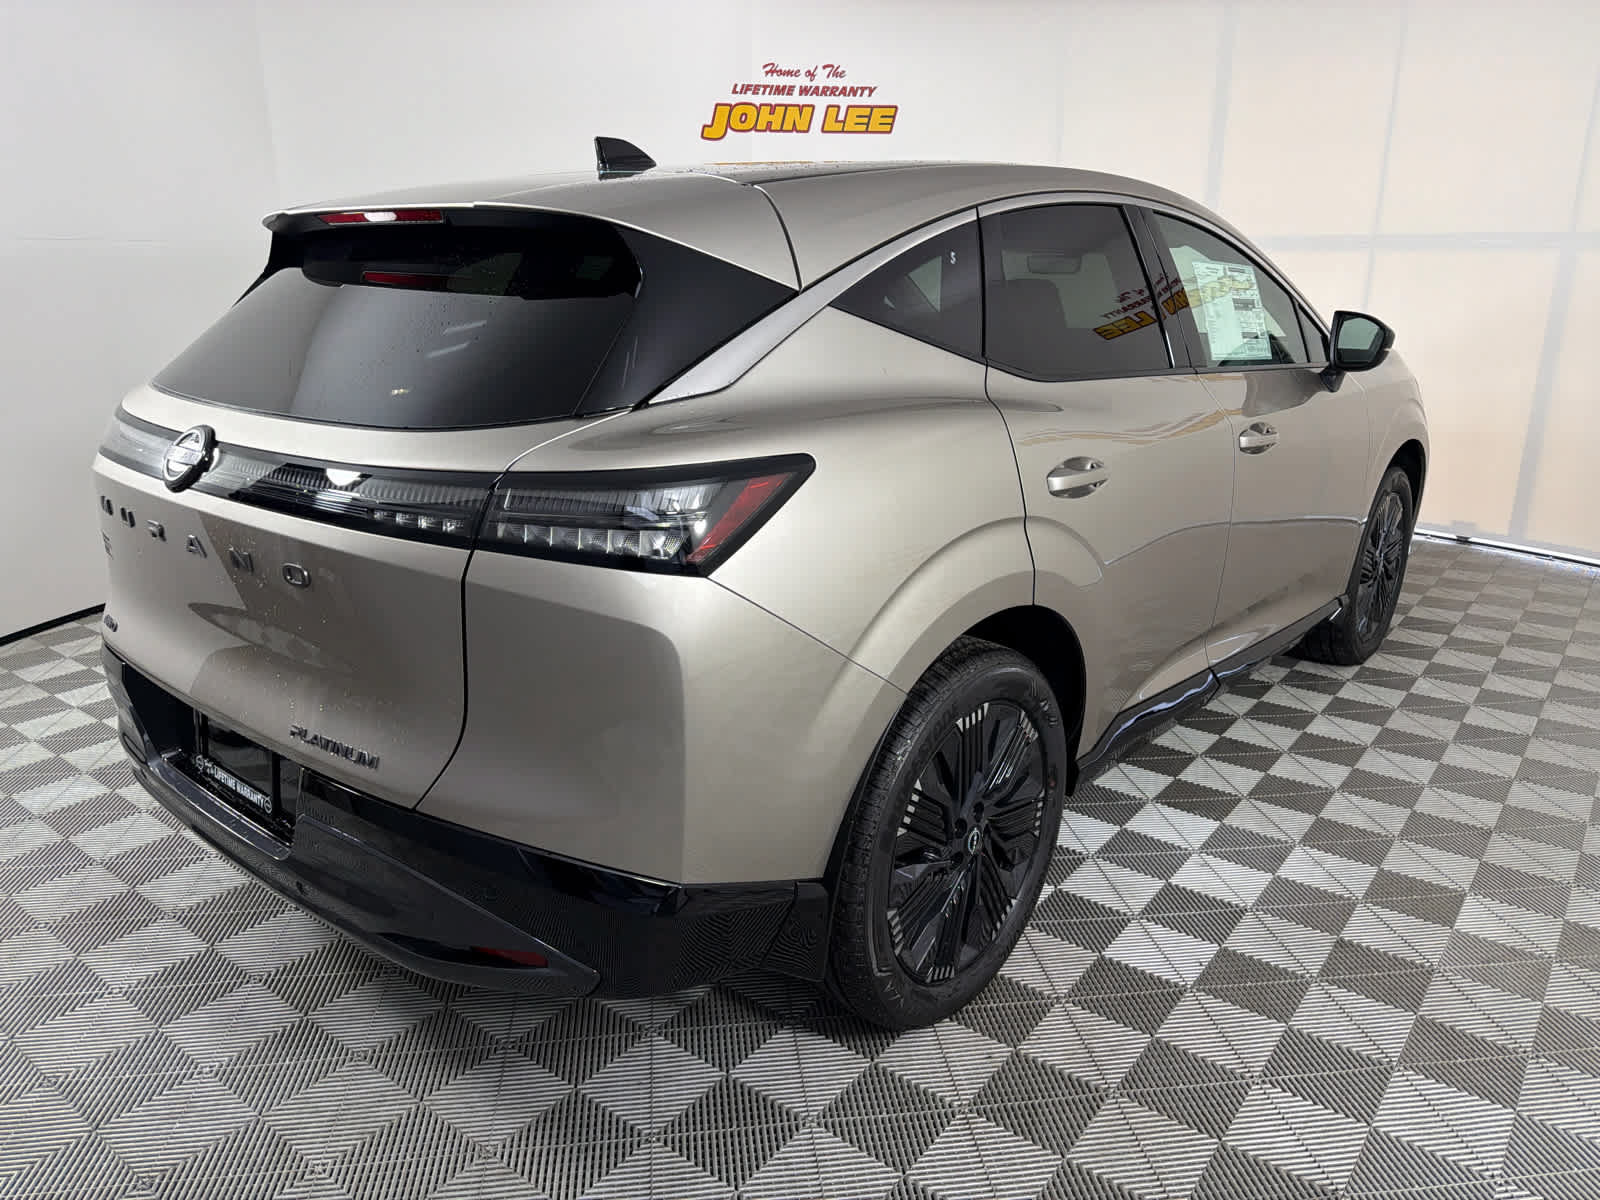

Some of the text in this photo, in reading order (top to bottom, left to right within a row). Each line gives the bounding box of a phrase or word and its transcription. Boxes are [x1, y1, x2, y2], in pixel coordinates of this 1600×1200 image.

[732, 83, 877, 97] LIFETIME WARRANTY
[762, 62, 846, 82] Home of The
[701, 102, 898, 141] JOHN LEE
[290, 724, 381, 770] PLATINUM
[213, 765, 236, 791] LIFETIME
[236, 780, 265, 809] WARRANTY
